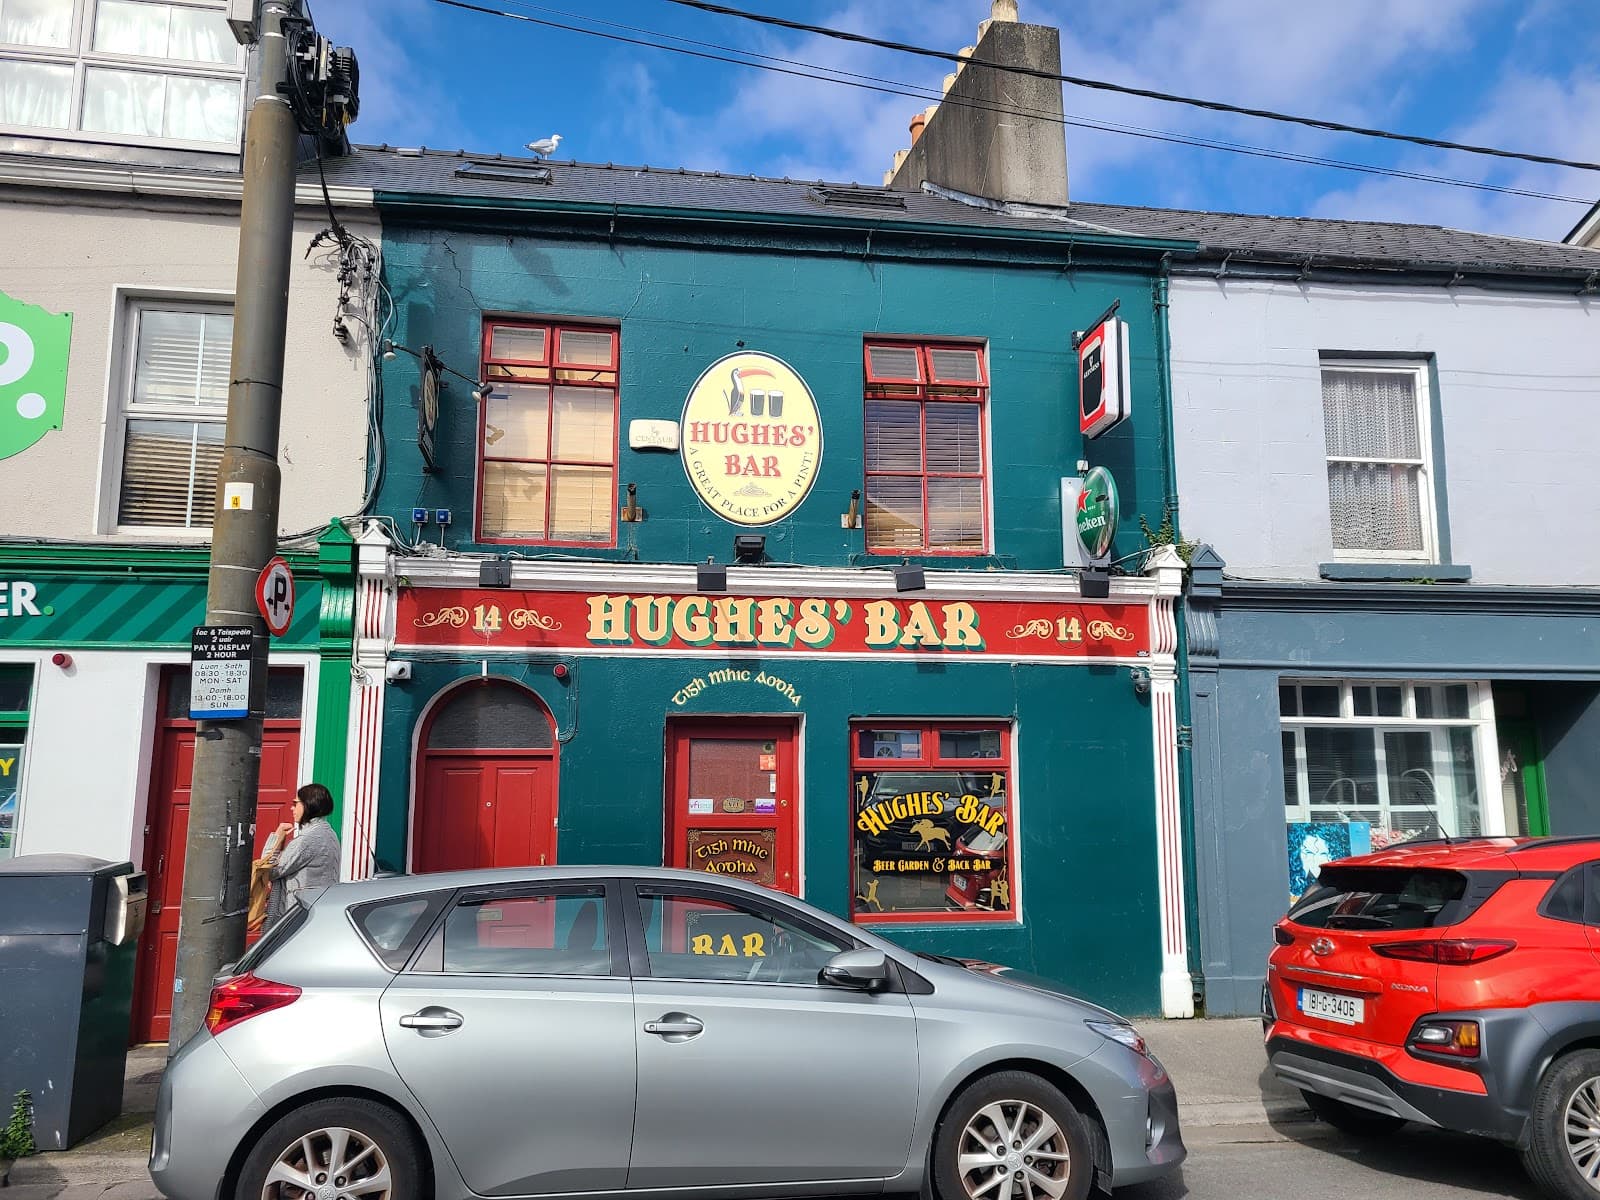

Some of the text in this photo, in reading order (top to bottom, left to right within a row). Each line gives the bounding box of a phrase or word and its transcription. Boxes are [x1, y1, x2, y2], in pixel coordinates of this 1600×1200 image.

[689, 421, 814, 447] HUGHES'
[724, 454, 782, 478] BAR
[689, 447, 814, 517] A GREAT PLACE FOR A PINT!
[273, 571, 288, 617] P
[472, 604, 503, 632] 14
[586, 594, 987, 651] HUGHES' BAR
[1056, 616, 1082, 642] 14
[193, 644, 209, 652] PAY
[218, 643, 251, 651] DISPLAY
[857, 791, 1006, 837] HUGHES' BAR
[873, 857, 992, 873] BEER GARDEN & BACK BAR
